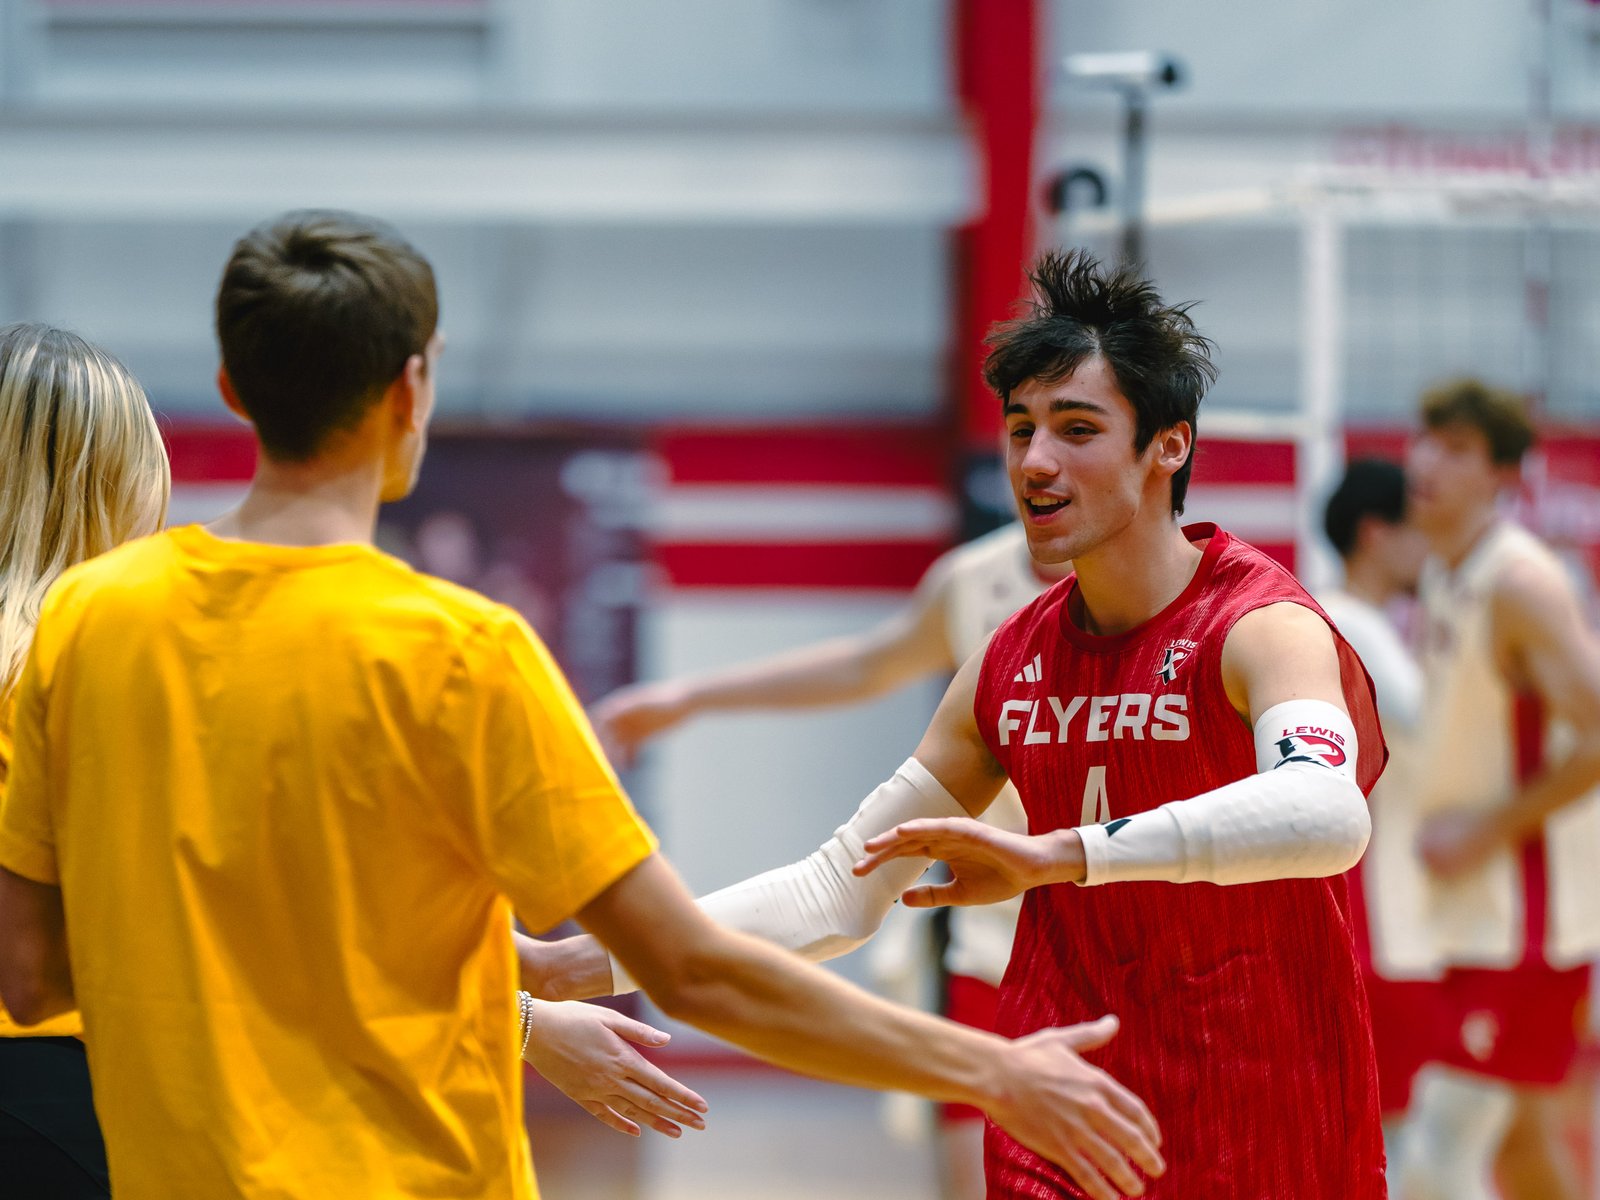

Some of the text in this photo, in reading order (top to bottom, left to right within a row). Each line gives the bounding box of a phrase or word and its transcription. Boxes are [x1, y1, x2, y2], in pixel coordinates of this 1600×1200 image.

[1170, 638, 1198, 649] LEWIS
[997, 692, 1191, 746] FLYERS
[1282, 726, 1345, 746] LEWIS
